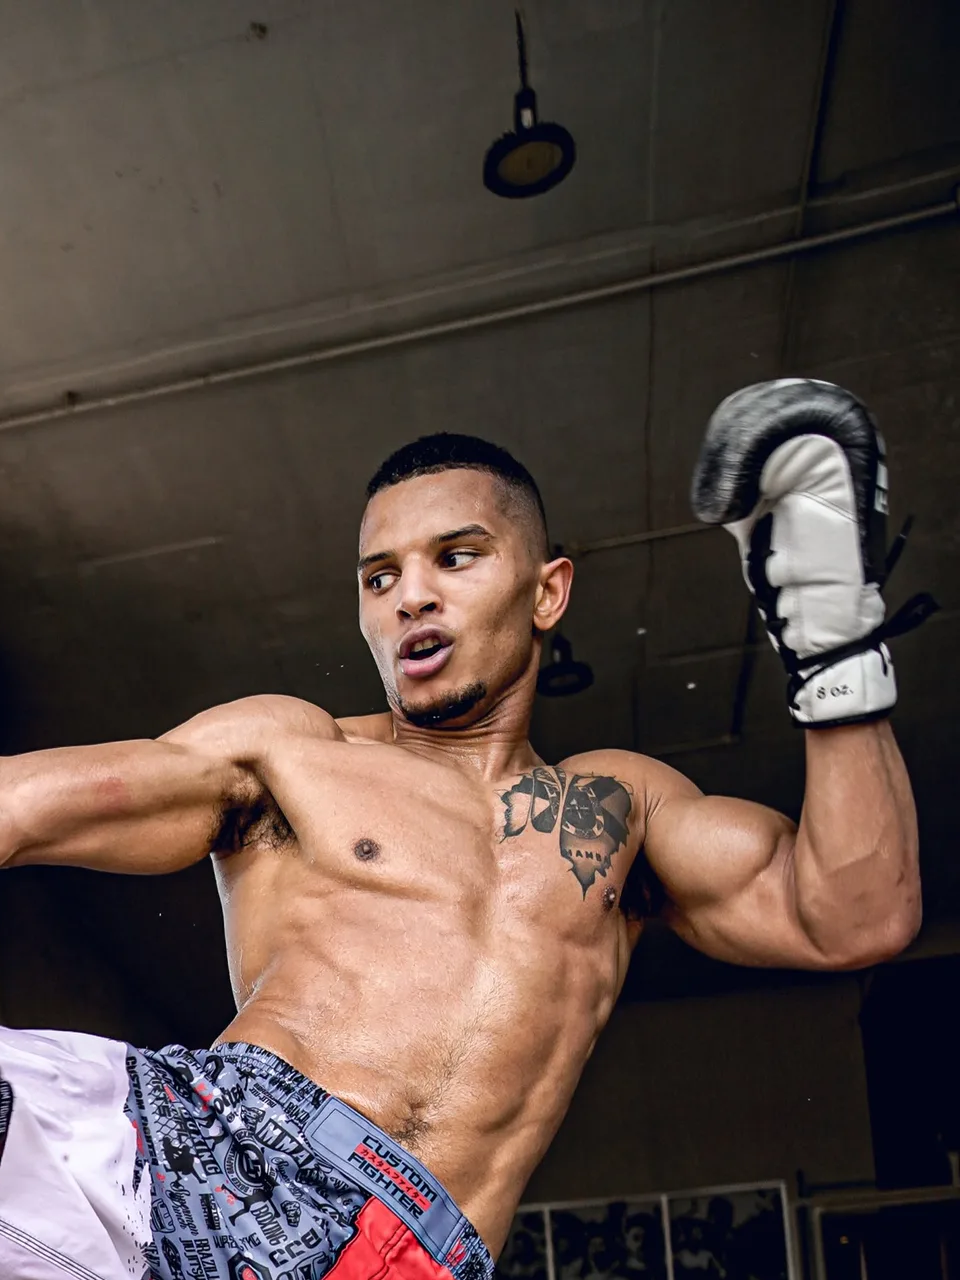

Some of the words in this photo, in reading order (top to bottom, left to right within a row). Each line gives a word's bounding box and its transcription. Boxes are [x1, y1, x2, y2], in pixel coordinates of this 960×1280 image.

[816, 686, 826, 700] 8
[258, 1121, 310, 1165] MMA
[347, 1152, 424, 1220] FIGHTER
[362, 1135, 438, 1202] CUSTOM
[250, 1203, 288, 1247] BOXING
